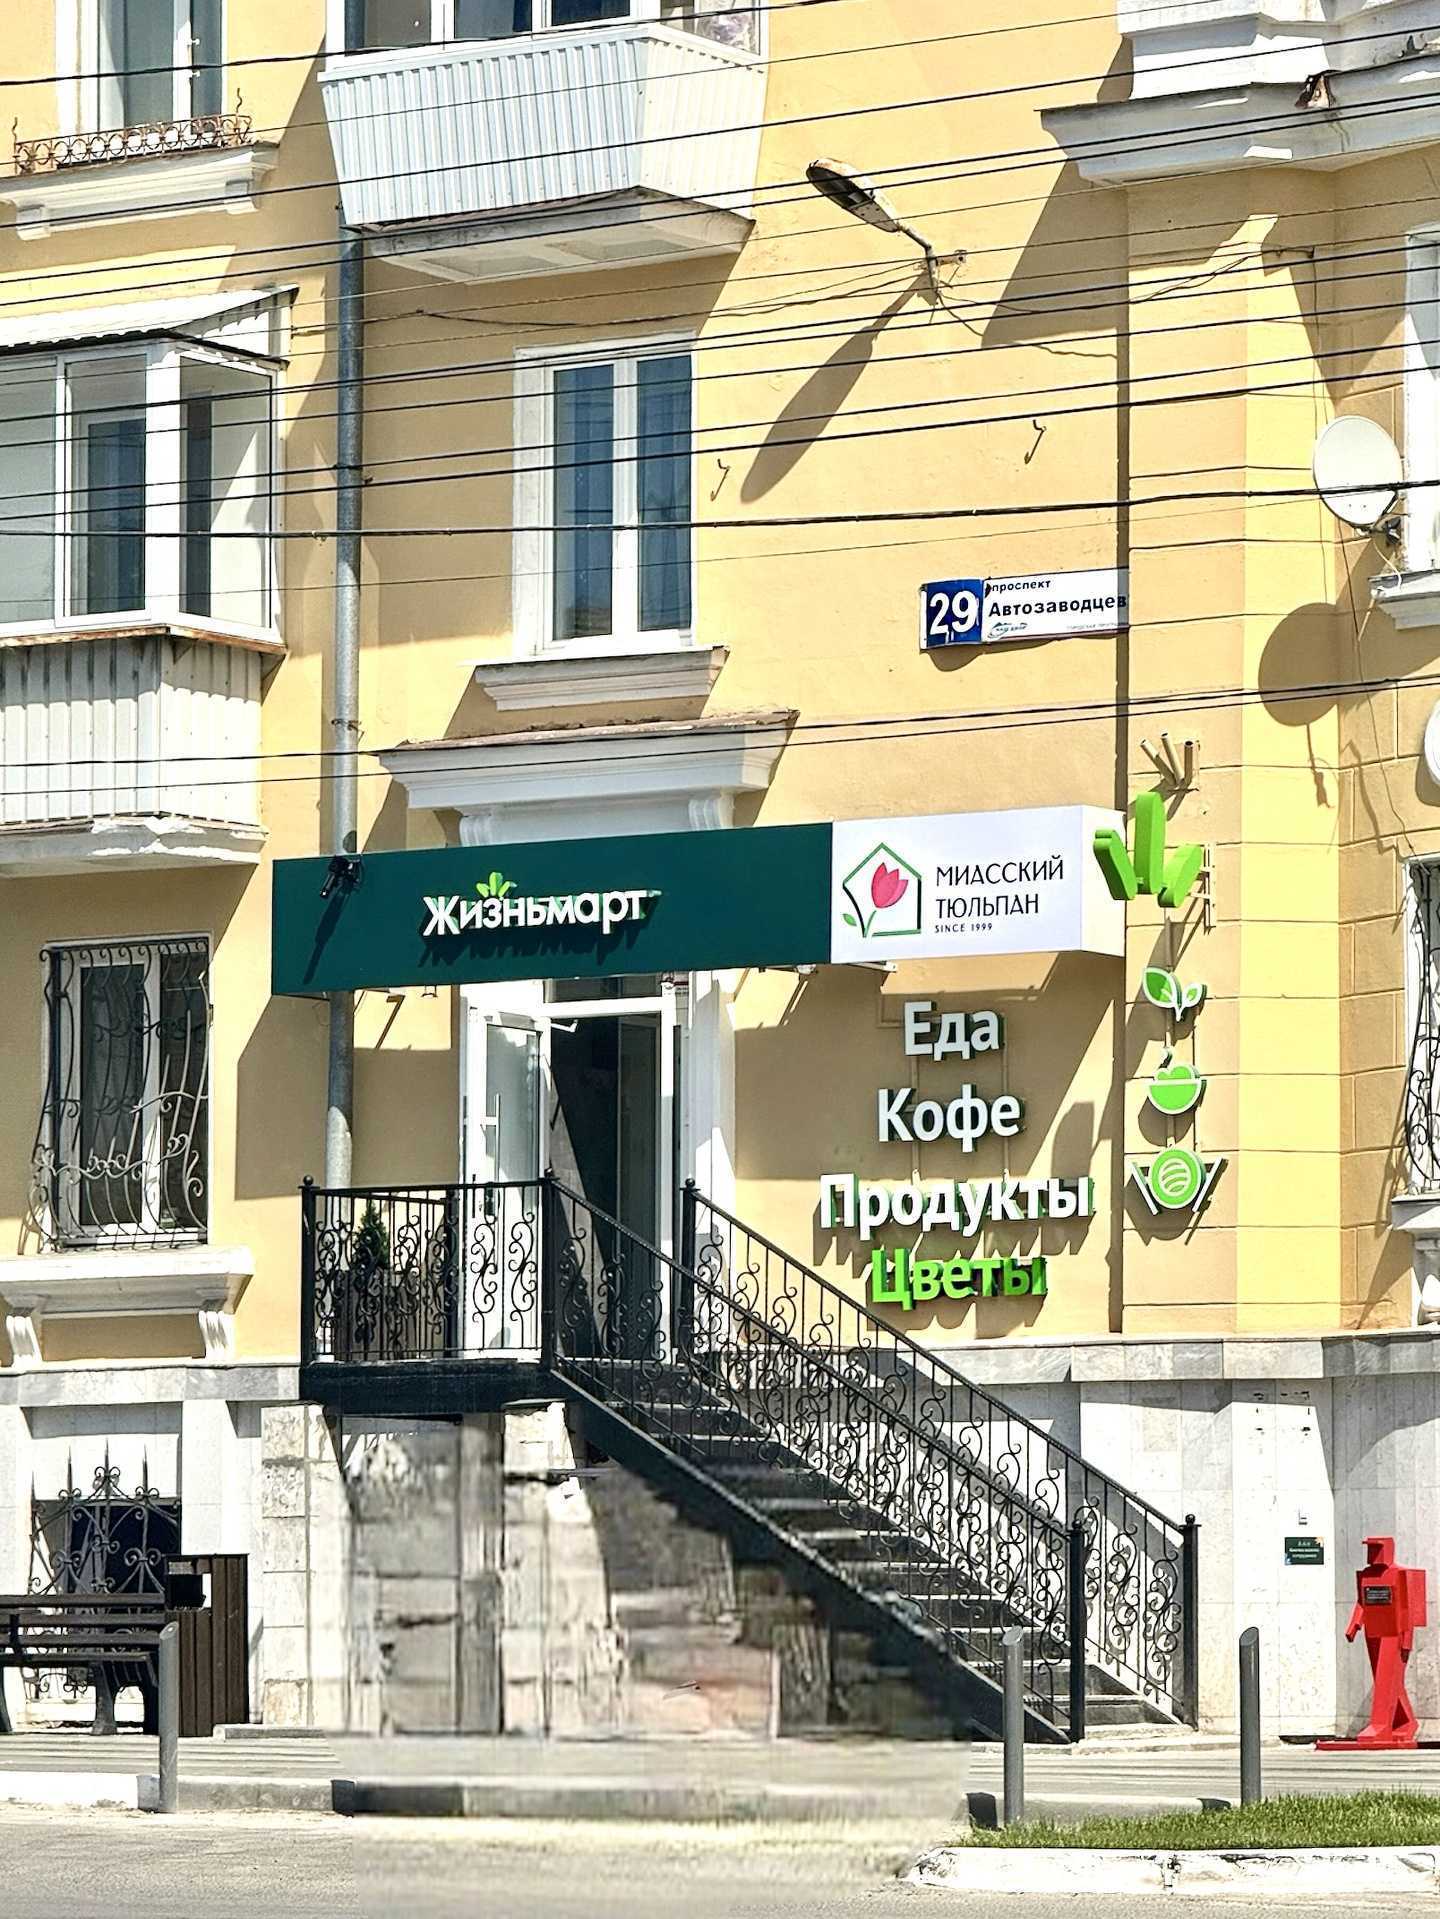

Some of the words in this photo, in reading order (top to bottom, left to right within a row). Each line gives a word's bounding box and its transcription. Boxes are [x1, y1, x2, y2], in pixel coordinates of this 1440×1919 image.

[989, 595, 1127, 617] Автозаводцев
[991, 579, 1051, 594] проспект
[929, 589, 978, 635] 29
[936, 854, 1064, 887] МИАССКИЙ
[423, 889, 649, 936] Жизньмарт
[934, 923, 966, 934] SINCE
[970, 922, 993, 933] 1999
[936, 893, 1039, 919] ТЮЛЬПАН
[904, 1001, 999, 1062] Еда
[878, 1083, 1021, 1153] Кофе
[819, 1172, 1091, 1241] Продукты
[871, 1248, 1047, 1311] Цветы
